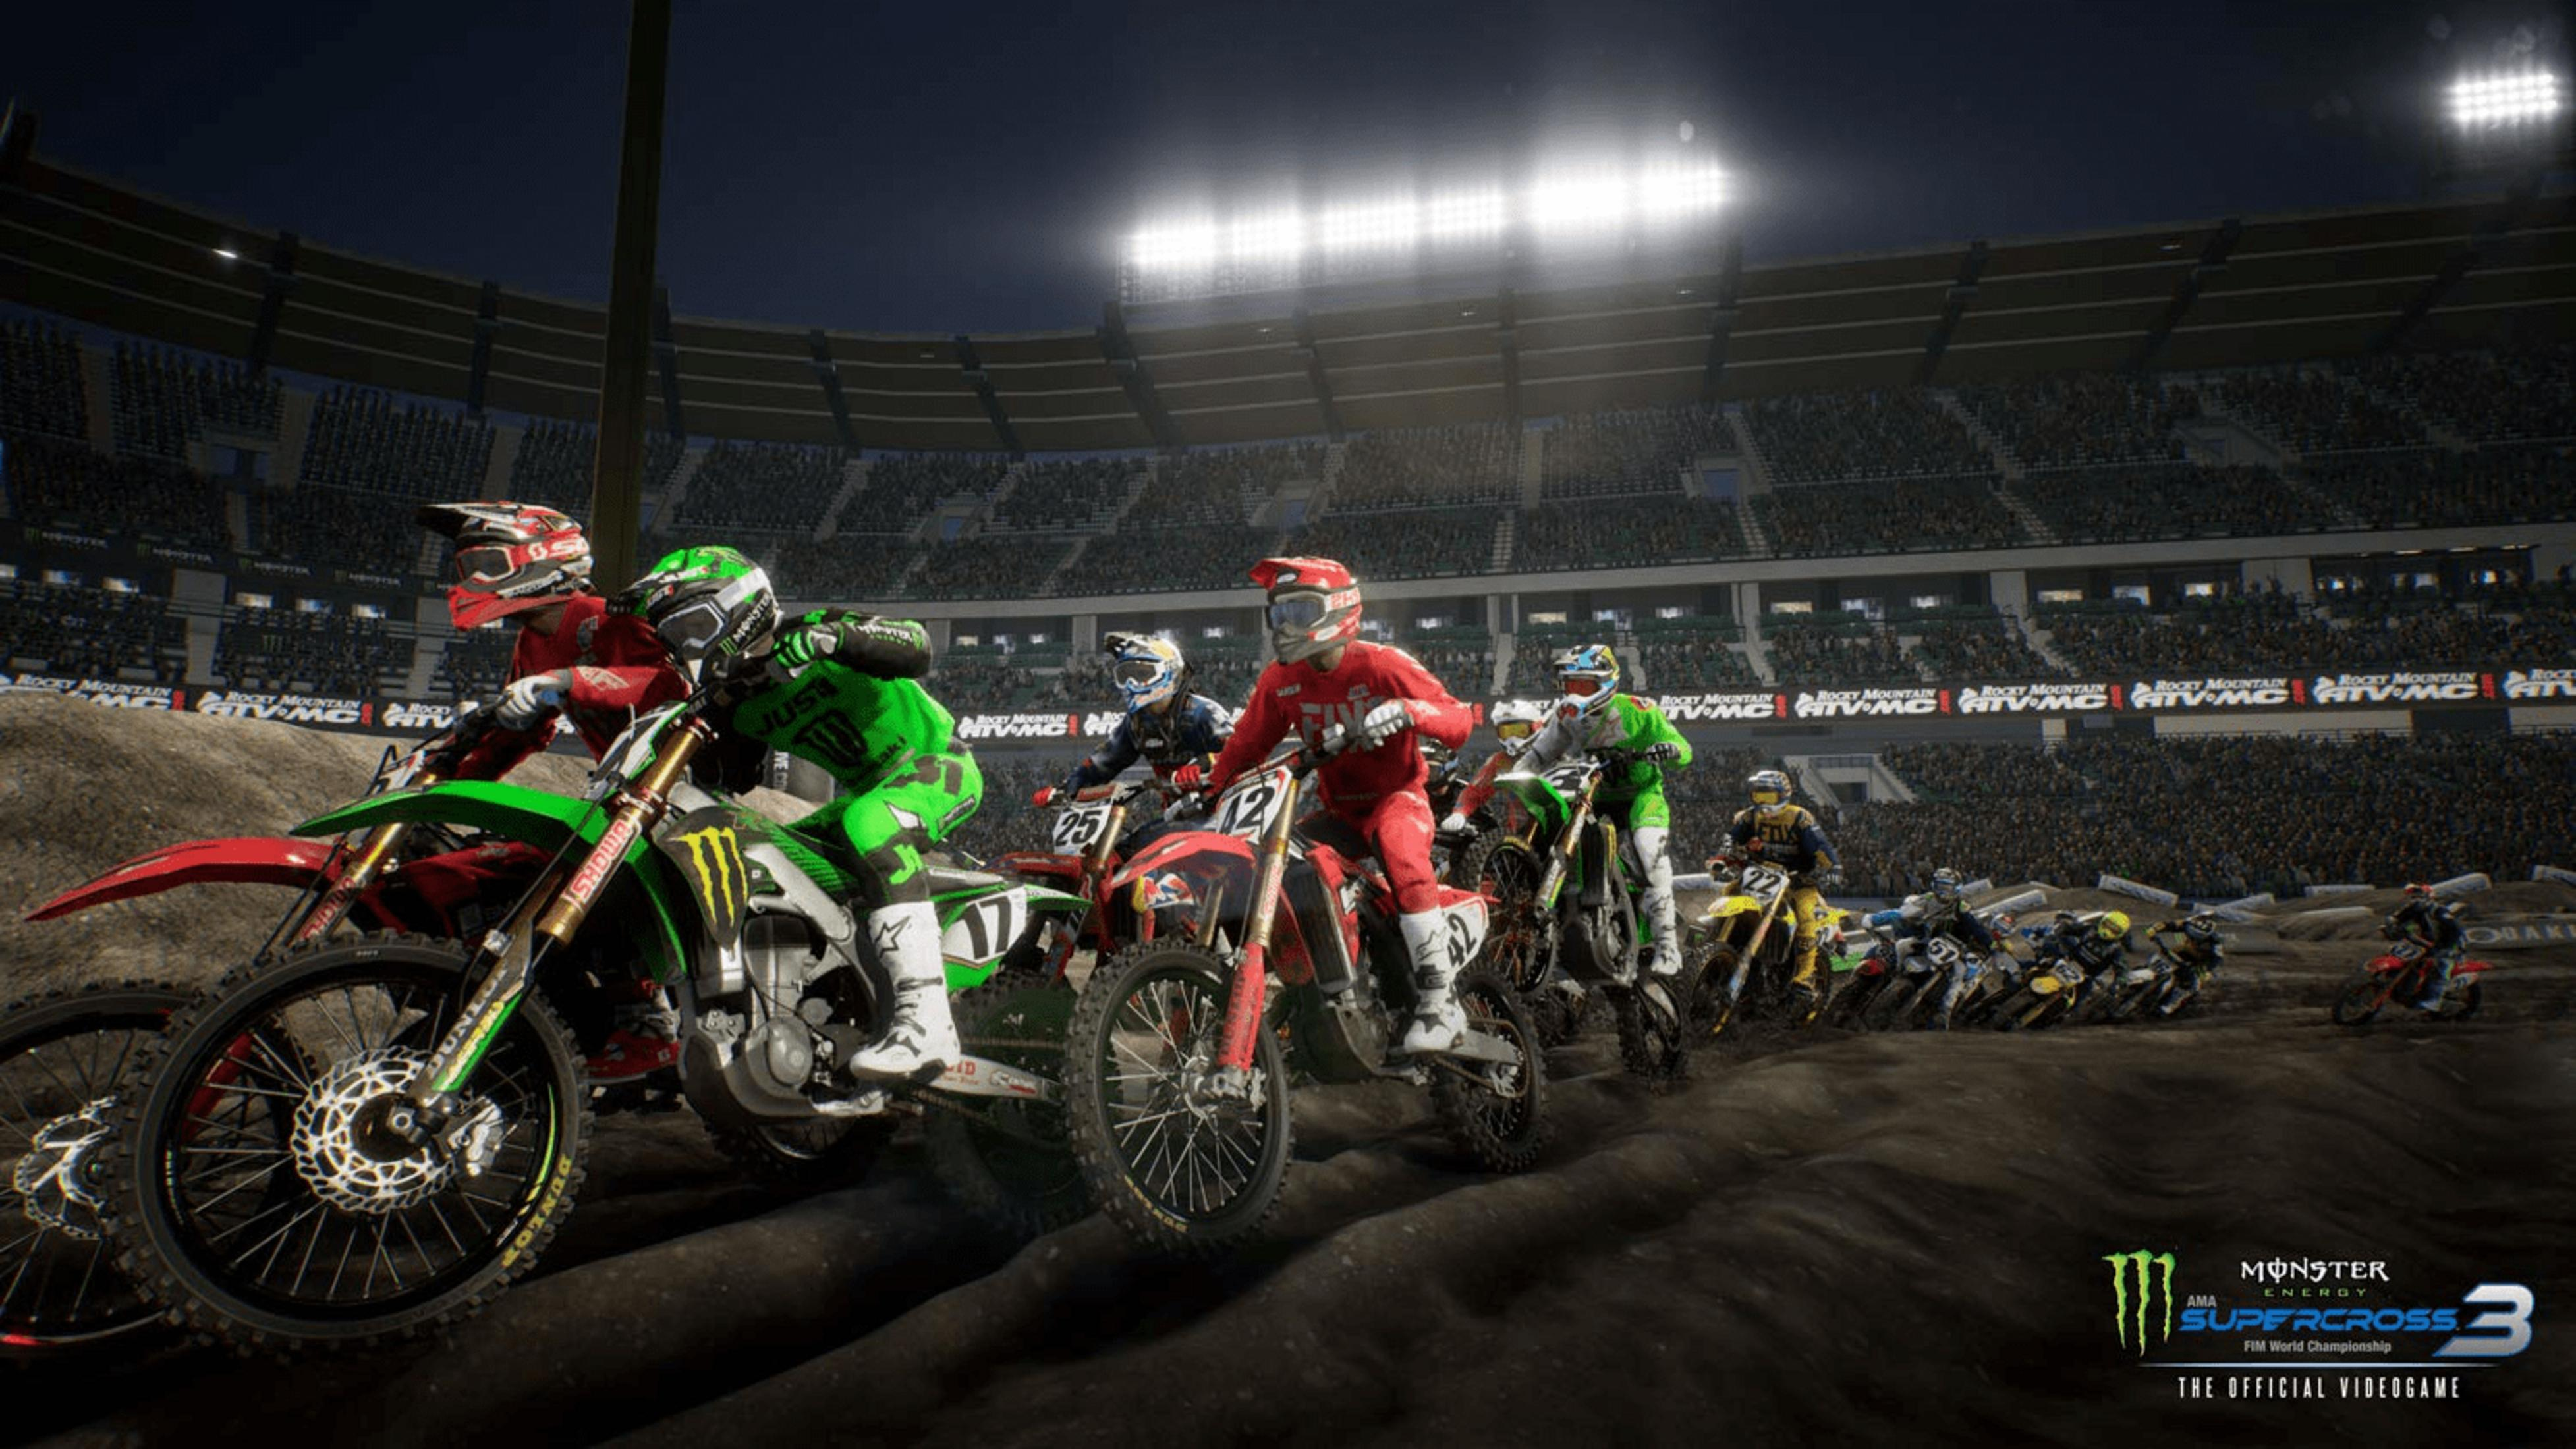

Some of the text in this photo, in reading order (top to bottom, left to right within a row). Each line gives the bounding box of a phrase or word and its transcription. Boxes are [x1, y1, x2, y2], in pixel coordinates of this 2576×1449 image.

[78, 678, 172, 696] MOUNTAIN
[2155, 678, 2287, 691] ROCKY MOUNTAIN
[2339, 672, 2477, 686] ROCKY MOUNTAIN
[1661, 694, 1774, 704] ROCKY MOUNTAIN
[1817, 688, 1936, 701] ROCKY MOUNTAIN
[1982, 683, 2107, 696] ROCKY MOUNTAIN
[224, 690, 362, 710] ROCKY MOUNTAIN
[977, 713, 1068, 724] ROCKY MOUNTAIN
[1055, 809, 1103, 847] 25
[569, 819, 633, 904] SHOWA
[1745, 869, 1781, 896] 22
[962, 896, 1012, 960] 17
[1447, 912, 1478, 967] 42
[501, 1153, 573, 1269] DUNLOP
